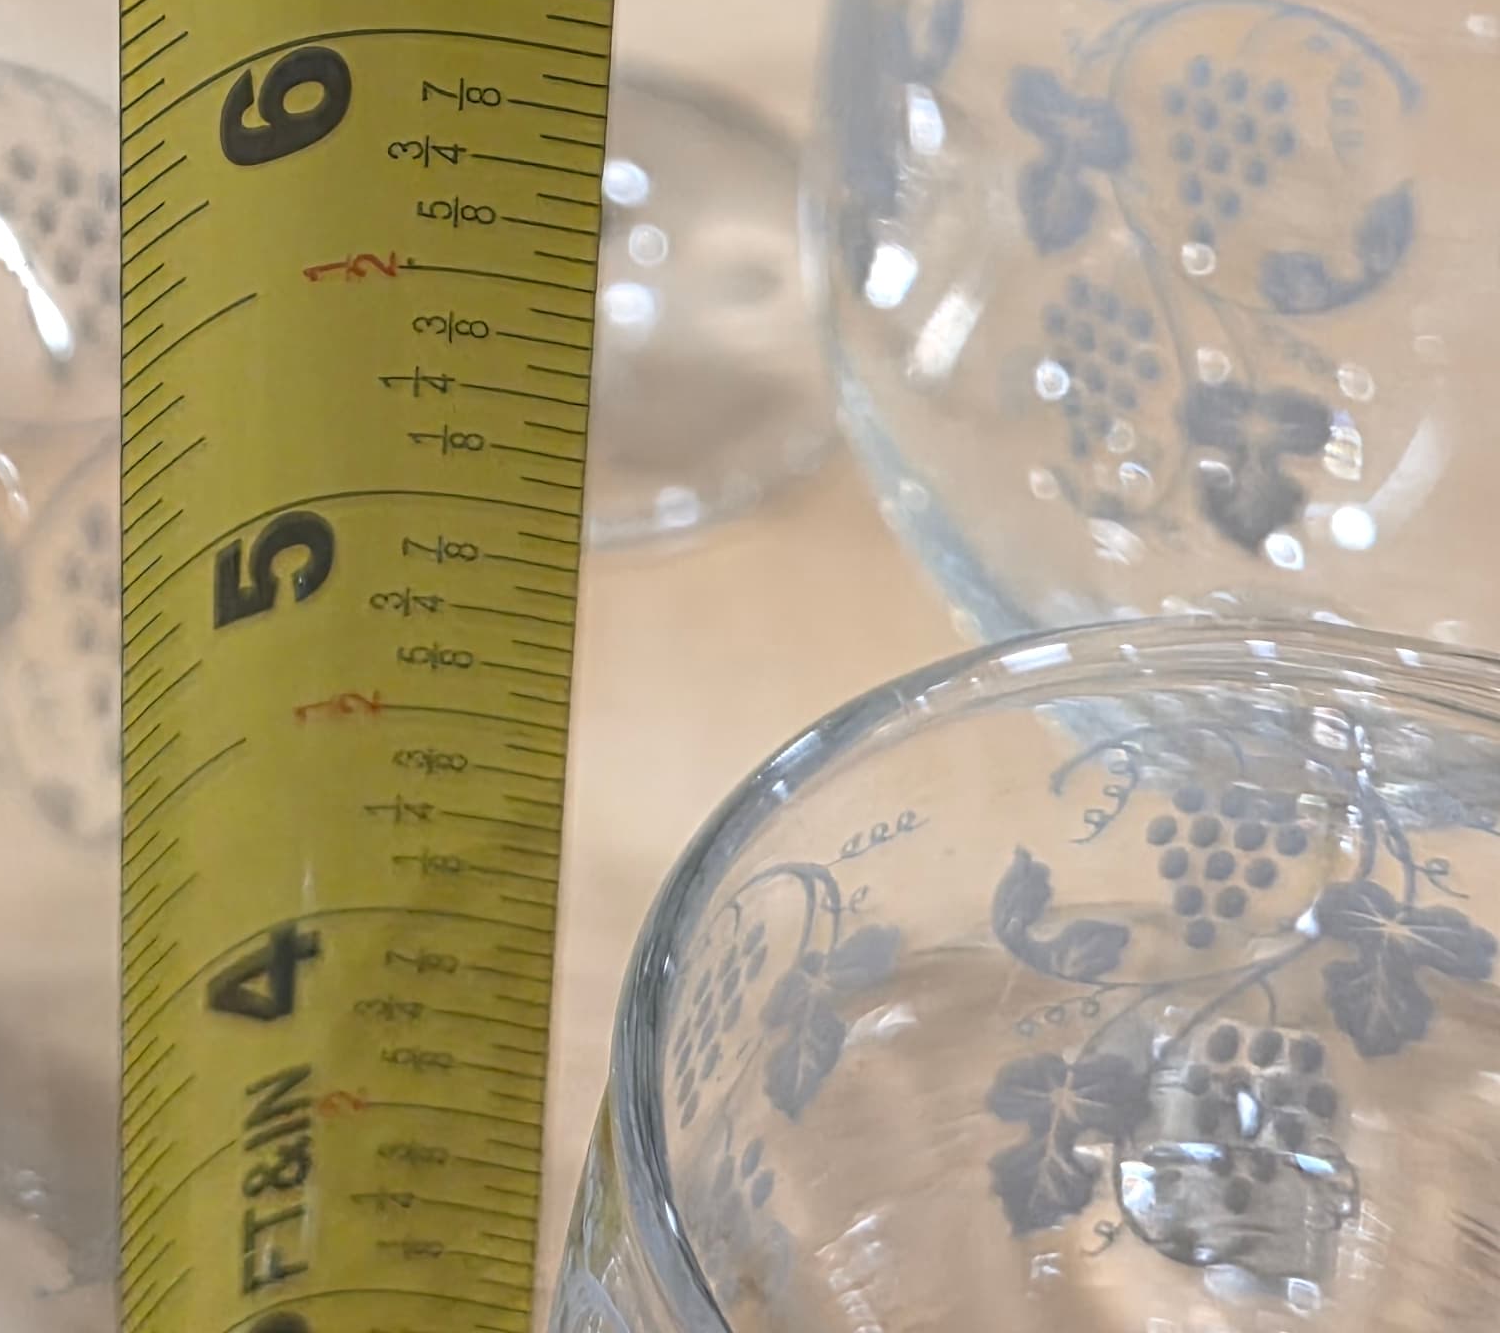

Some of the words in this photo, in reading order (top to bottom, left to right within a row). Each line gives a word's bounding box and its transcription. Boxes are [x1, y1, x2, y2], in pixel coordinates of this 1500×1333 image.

[219, 45, 353, 166] 6
[213, 509, 335, 630] 5
[207, 919, 322, 1022] 4
[242, 1063, 312, 1295] FT&IN
